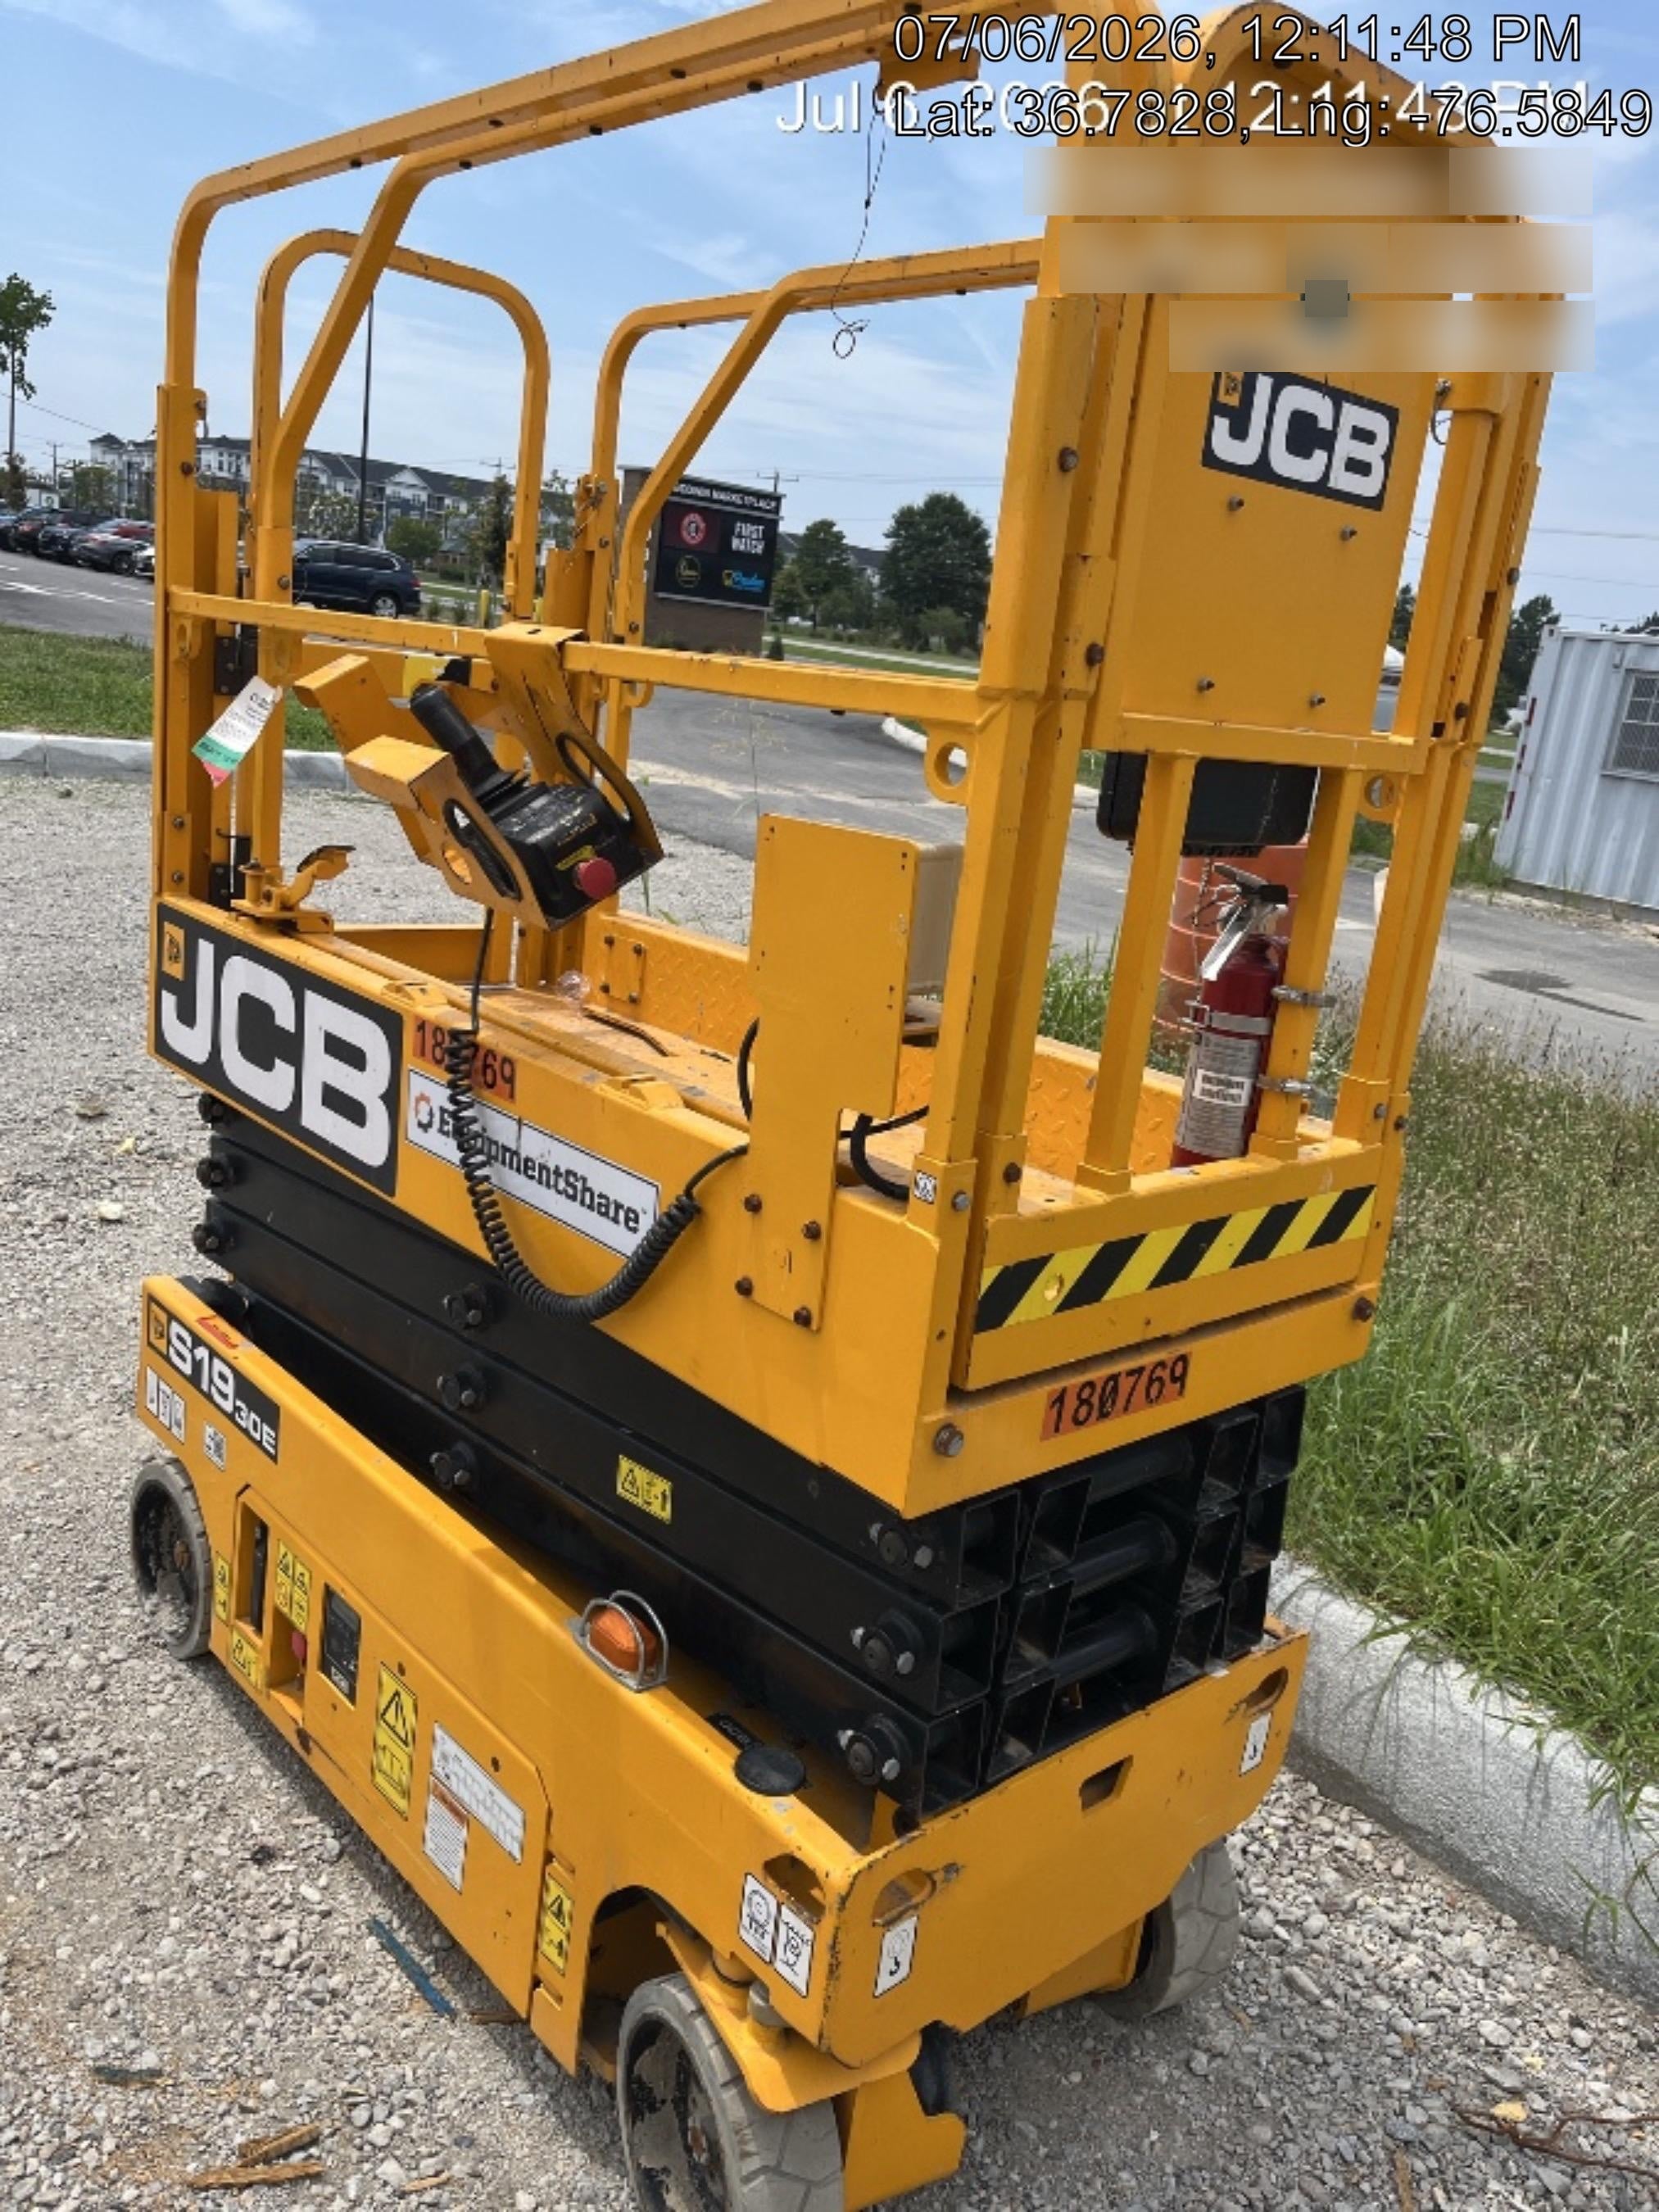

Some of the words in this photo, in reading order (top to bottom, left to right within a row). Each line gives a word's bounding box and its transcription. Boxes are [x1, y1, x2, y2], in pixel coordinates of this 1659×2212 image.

[1211, 373, 1390, 498] JCB
[161, 938, 392, 1168] JCB
[416, 1019, 516, 1101] 1869
[437, 1105, 640, 1235] EipmentShare
[1049, 1353, 1190, 1434] 180769
